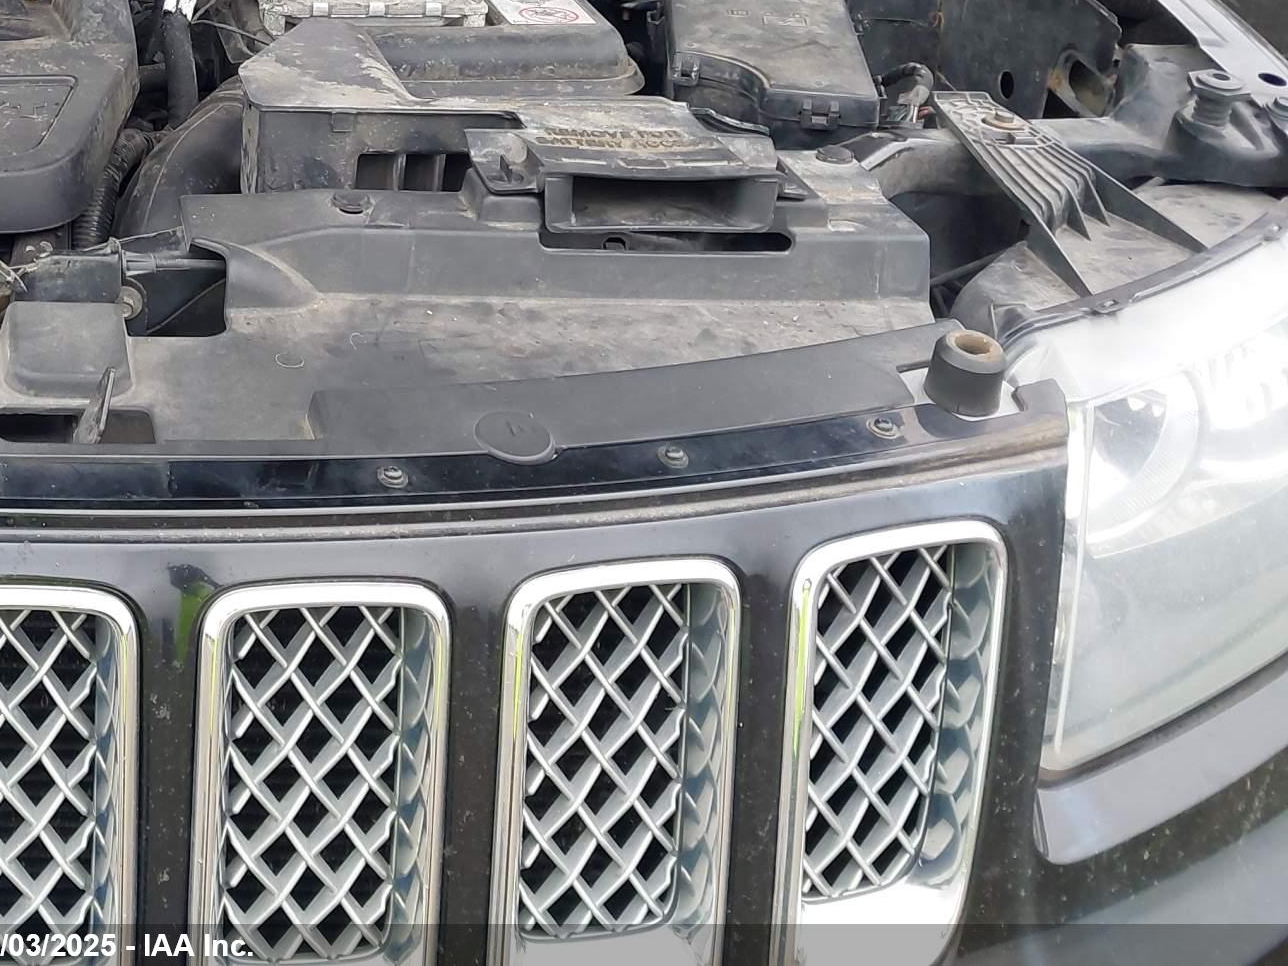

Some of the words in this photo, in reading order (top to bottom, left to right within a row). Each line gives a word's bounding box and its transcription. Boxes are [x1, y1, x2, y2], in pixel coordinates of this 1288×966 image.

[544, 127, 633, 139] REMOVE
[637, 129, 682, 139] FOR
[535, 136, 623, 148] BATTERY
